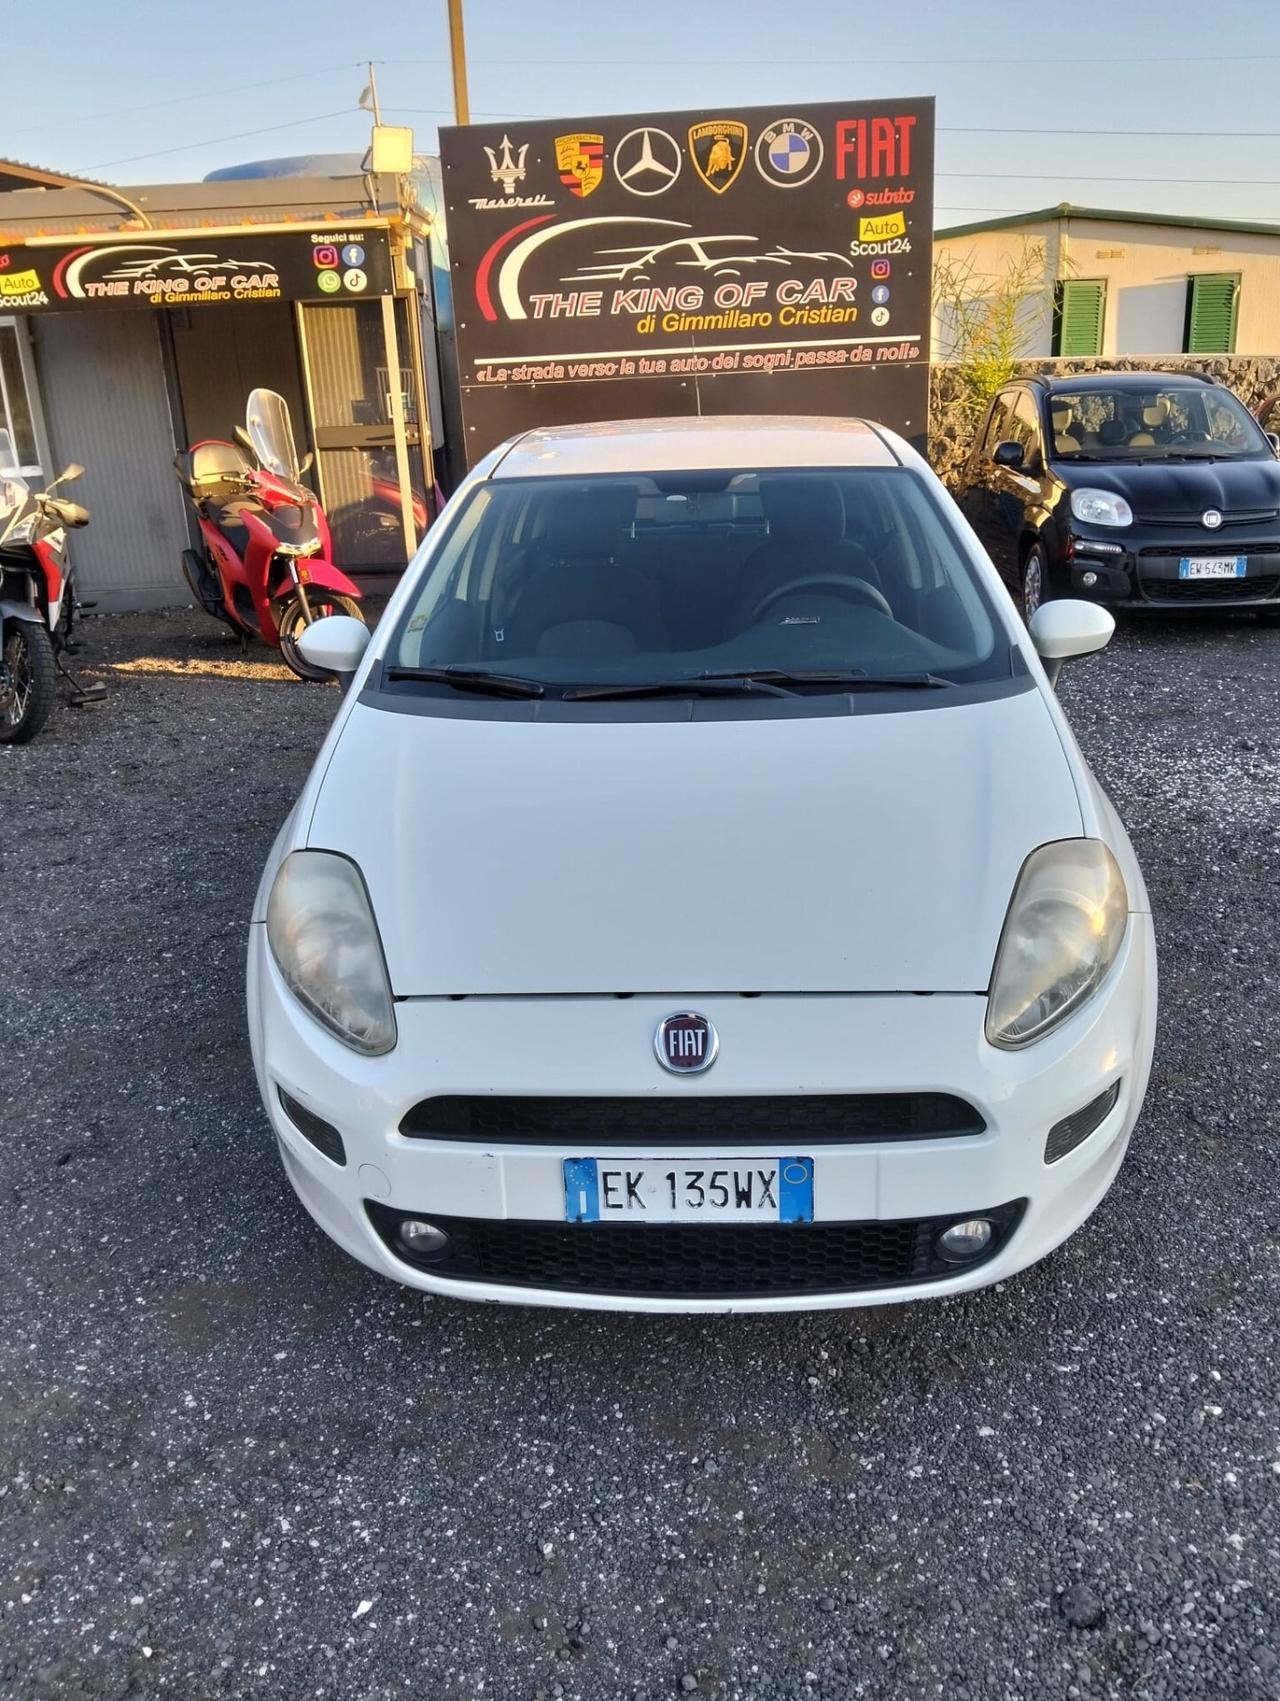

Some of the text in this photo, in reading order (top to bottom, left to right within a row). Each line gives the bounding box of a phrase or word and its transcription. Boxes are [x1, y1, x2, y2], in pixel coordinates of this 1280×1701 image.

[555, 134, 602, 146] PORSCHE
[692, 125, 743, 140] LAMBORGHINI
[764, 122, 814, 144] BMW
[836, 116, 917, 180] FIAT
[468, 194, 555, 210] Maserati
[865, 187, 915, 205] subito
[863, 221, 900, 236] Auto
[310, 233, 364, 244] Seguici su:
[850, 238, 912, 256] Scout24
[4, 277, 35, 290] Auto
[85, 273, 280, 297] THE KING OF CAR
[150, 286, 281, 304] di Gimmillaro Cristian
[529, 277, 858, 319] THE KING OF CAR
[636, 304, 858, 334] di Gimmillaro Cristian
[511, 362, 564, 381] strada
[568, 362, 617, 377] verso
[619, 358, 635, 375] la
[639, 357, 666, 374] tua
[670, 353, 708, 372] auto
[712, 351, 739, 370] dei
[742, 349, 792, 371] sogni
[794, 348, 847, 369] passa
[850, 345, 873, 362] da
[669, 1029, 706, 1057] FIAT
[602, 1171, 647, 1209] EK
[665, 1170, 778, 1209] 135WX
